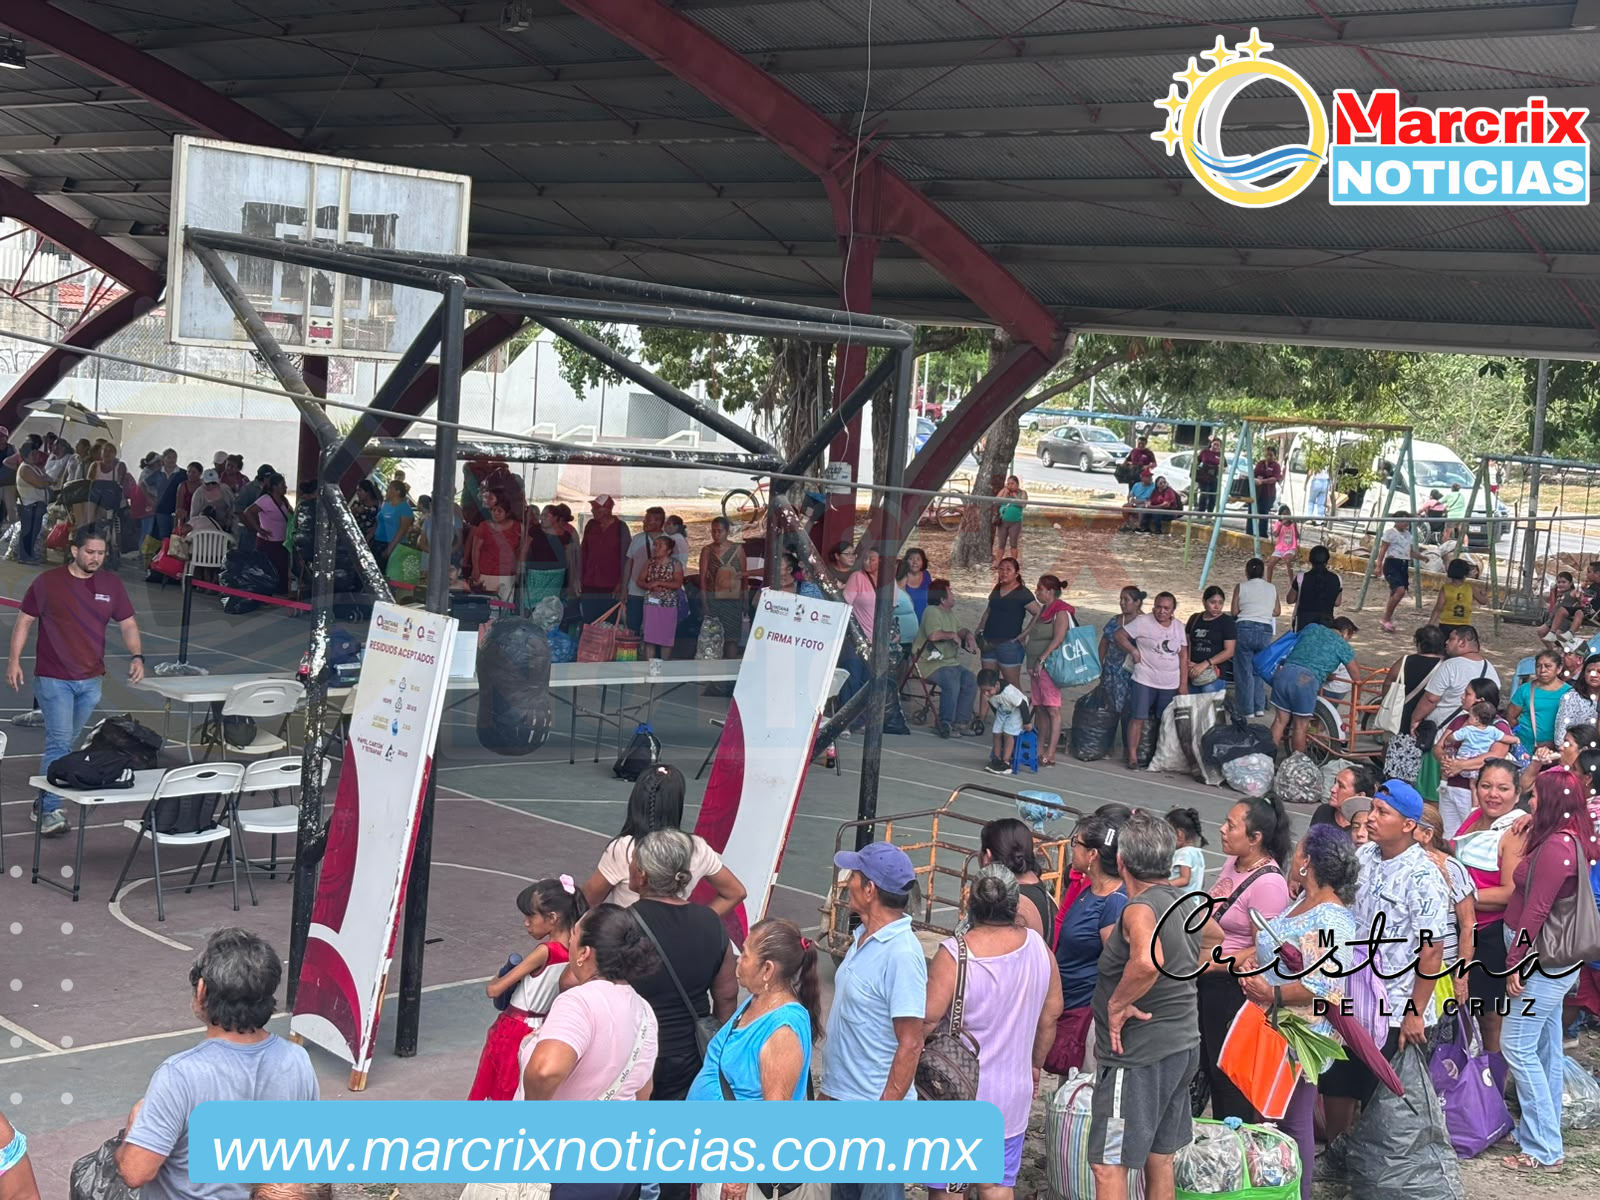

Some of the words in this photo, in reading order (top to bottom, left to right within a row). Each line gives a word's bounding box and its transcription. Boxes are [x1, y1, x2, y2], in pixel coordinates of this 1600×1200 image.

[767, 631, 793, 645] FIRMA
[794, 637, 801, 646] Y
[801, 638, 825, 651] FOTO
[370, 640, 398, 656] RESIDUOS
[398, 647, 435, 665] ACEPTADOS
